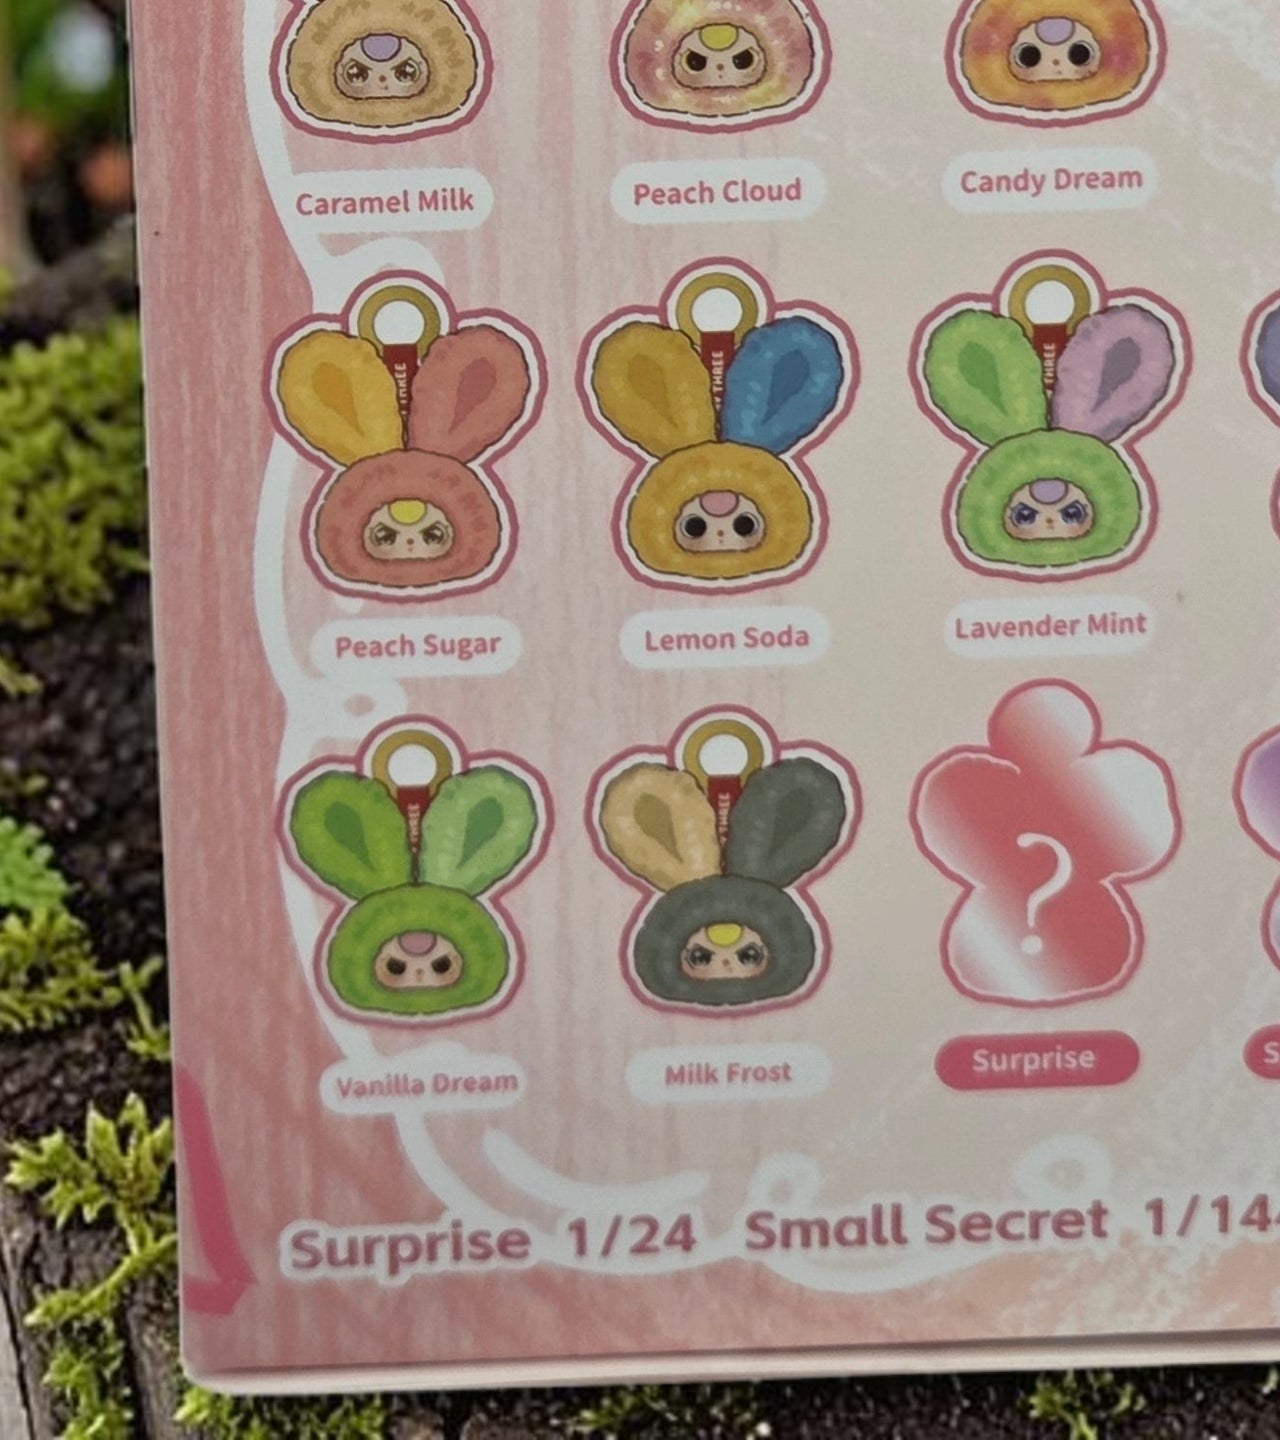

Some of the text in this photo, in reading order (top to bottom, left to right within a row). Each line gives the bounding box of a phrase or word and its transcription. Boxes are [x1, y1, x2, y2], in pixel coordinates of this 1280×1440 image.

[632, 177, 803, 207] Peach Cloud
[959, 167, 1144, 198] Candy Dream
[295, 186, 475, 217] Caramel Milk
[712, 351, 724, 392] THREE
[1043, 343, 1056, 384] THREE
[643, 623, 811, 653] Lemon Soda
[954, 611, 1147, 640] Lavender Mint
[334, 633, 502, 661] Peach Sugar
[663, 1060, 793, 1086] Milk Frost
[971, 1044, 1096, 1077] Surprise
[335, 1071, 519, 1100] Vanilla Dream
[289, 1218, 531, 1278] Surprise
[566, 1212, 697, 1258] 1/24
[744, 1202, 908, 1252] Small
[923, 1198, 1109, 1246] Secret
